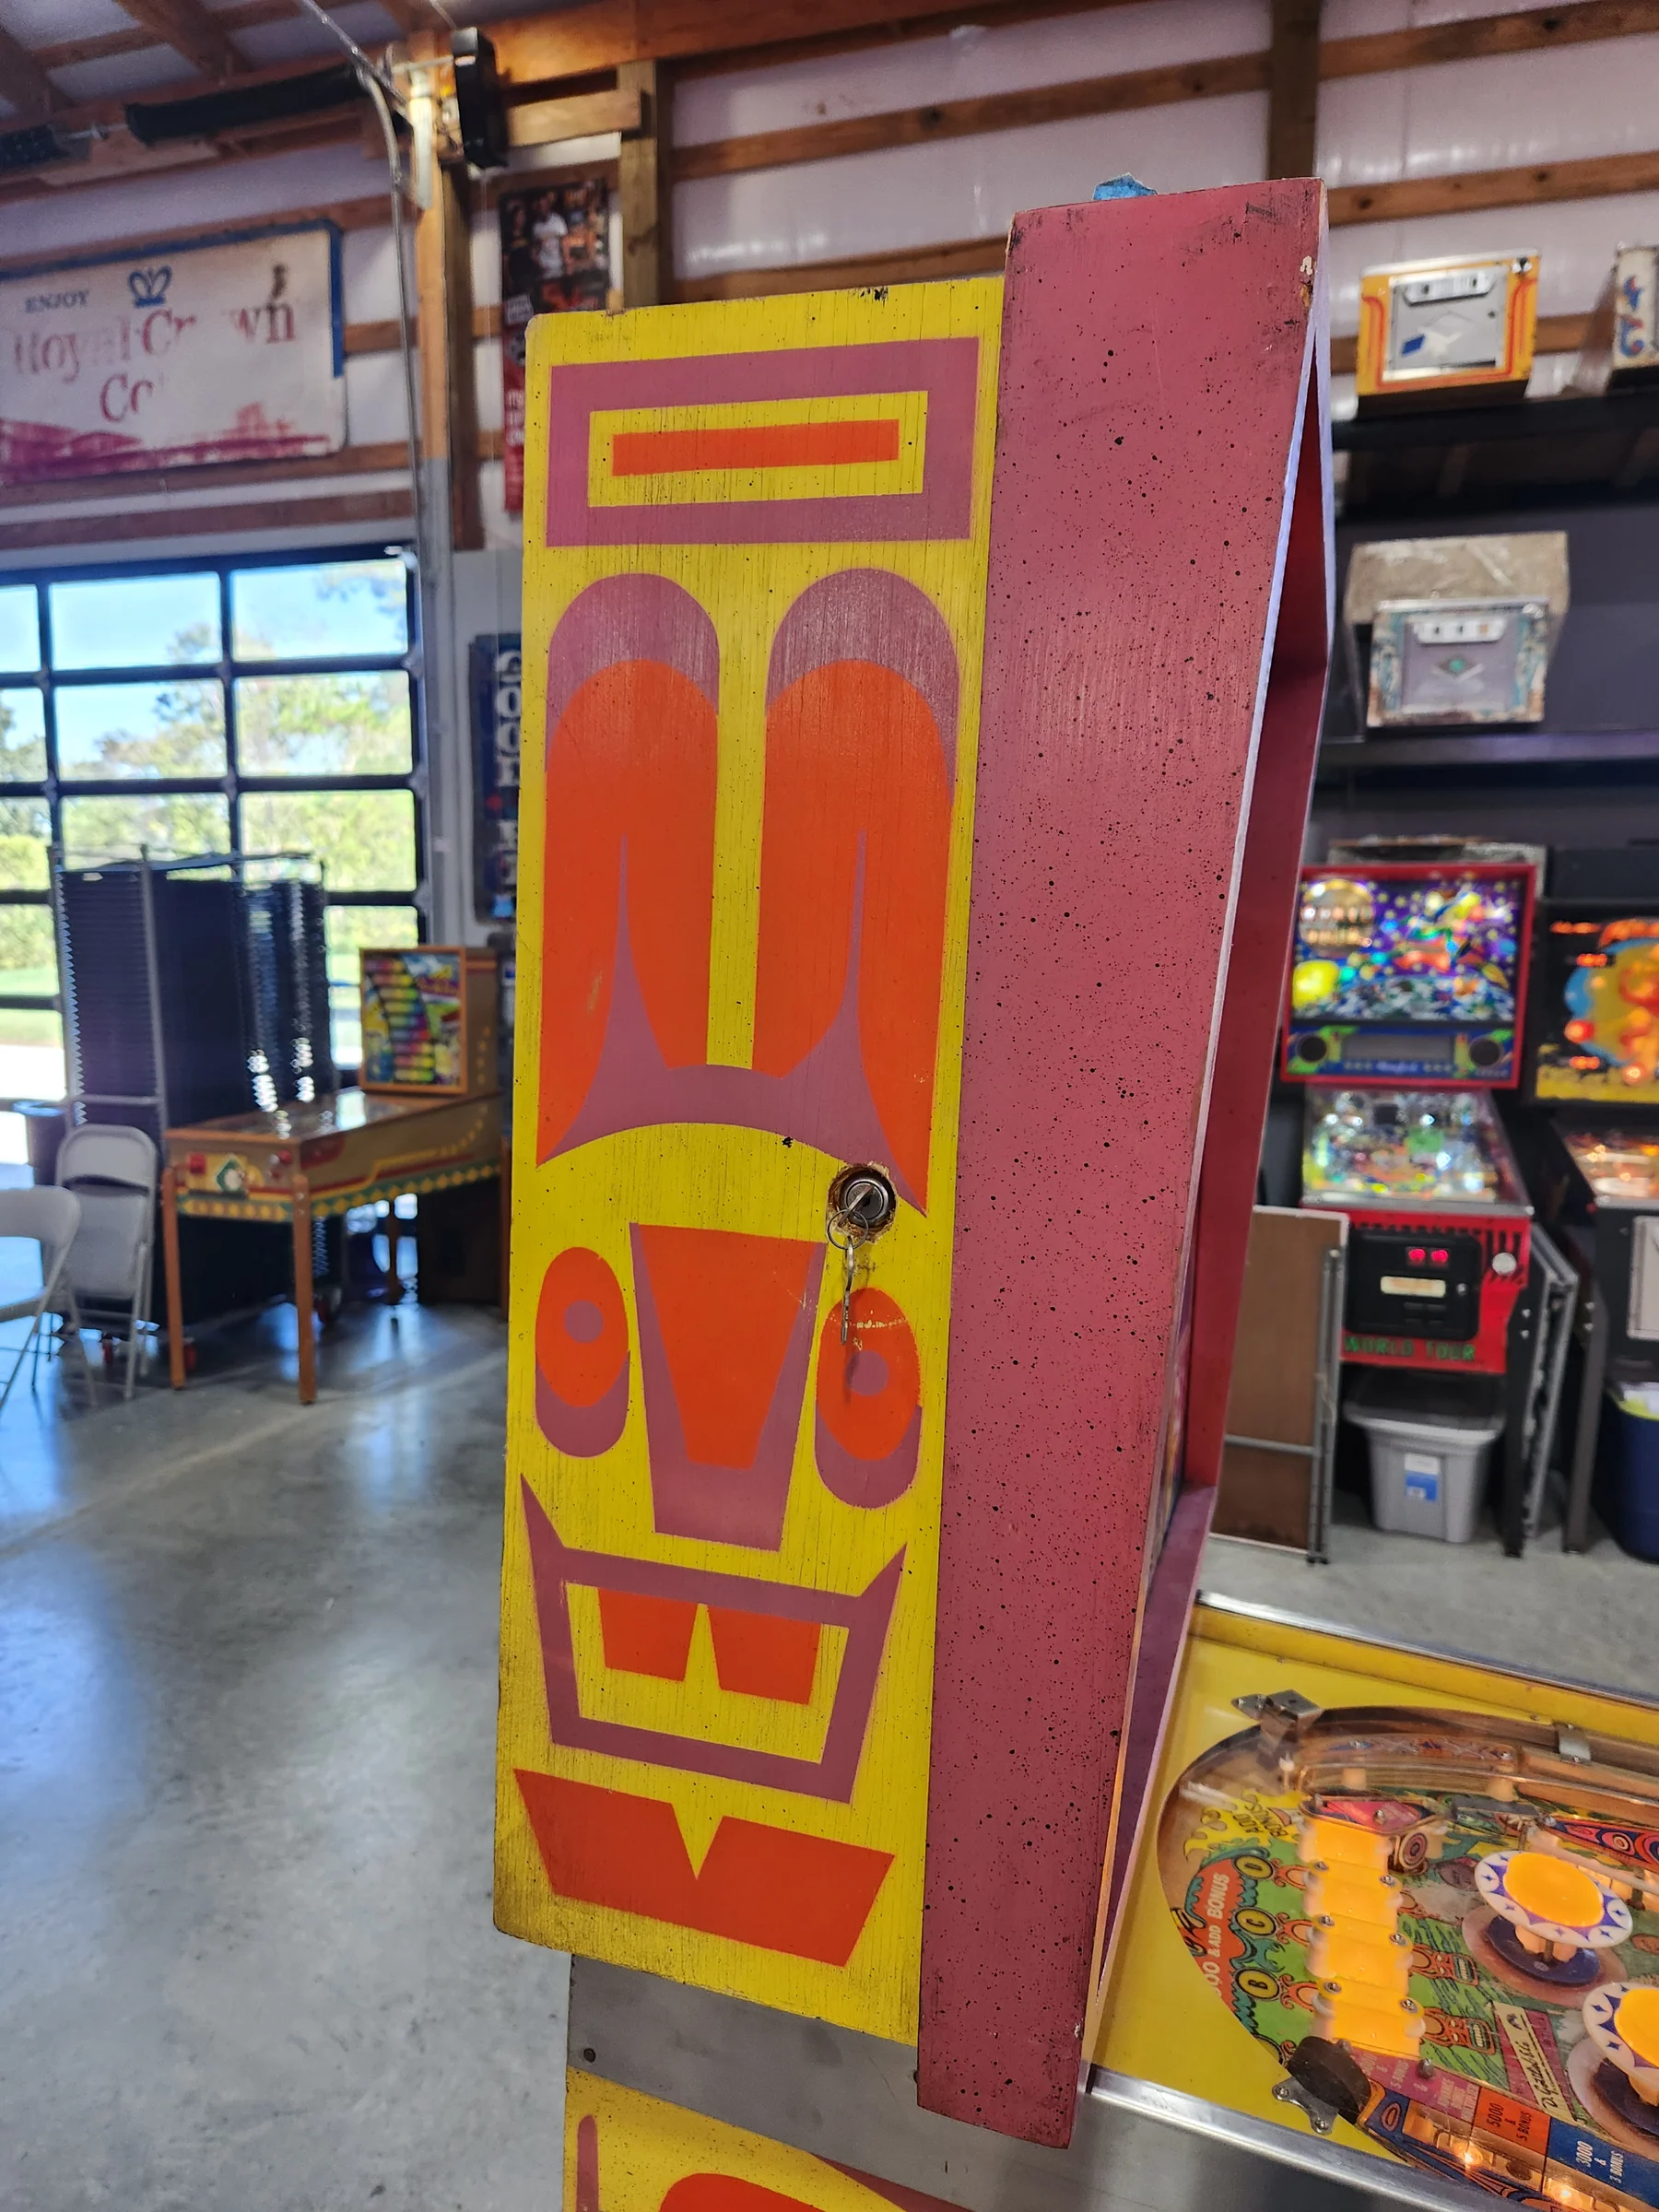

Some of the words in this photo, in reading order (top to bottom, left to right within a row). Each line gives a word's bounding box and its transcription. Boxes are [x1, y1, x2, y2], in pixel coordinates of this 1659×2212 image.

[25, 290, 88, 312] ENJOY
[142, 307, 295, 357] Crwn
[1345, 1335, 1415, 1358] WORLD
[1425, 1341, 1477, 1361] TOUR
[1206, 1872, 1230, 1920] BONUS
[1246, 1917, 1266, 1928] C
[1207, 1924, 1222, 1946] ADD
[1248, 1979, 1269, 1990] B
[1486, 2102, 1504, 2128] 5000
[1504, 2118, 1516, 2126] &
[1518, 2111, 1533, 2135] BONUS
[1516, 2134, 1528, 2142] 5
[1575, 2141, 1594, 2168] 3000
[1594, 2157, 1607, 2167] &
[1610, 2150, 1625, 2176] BONUS
[1609, 2174, 1622, 2184] 3
